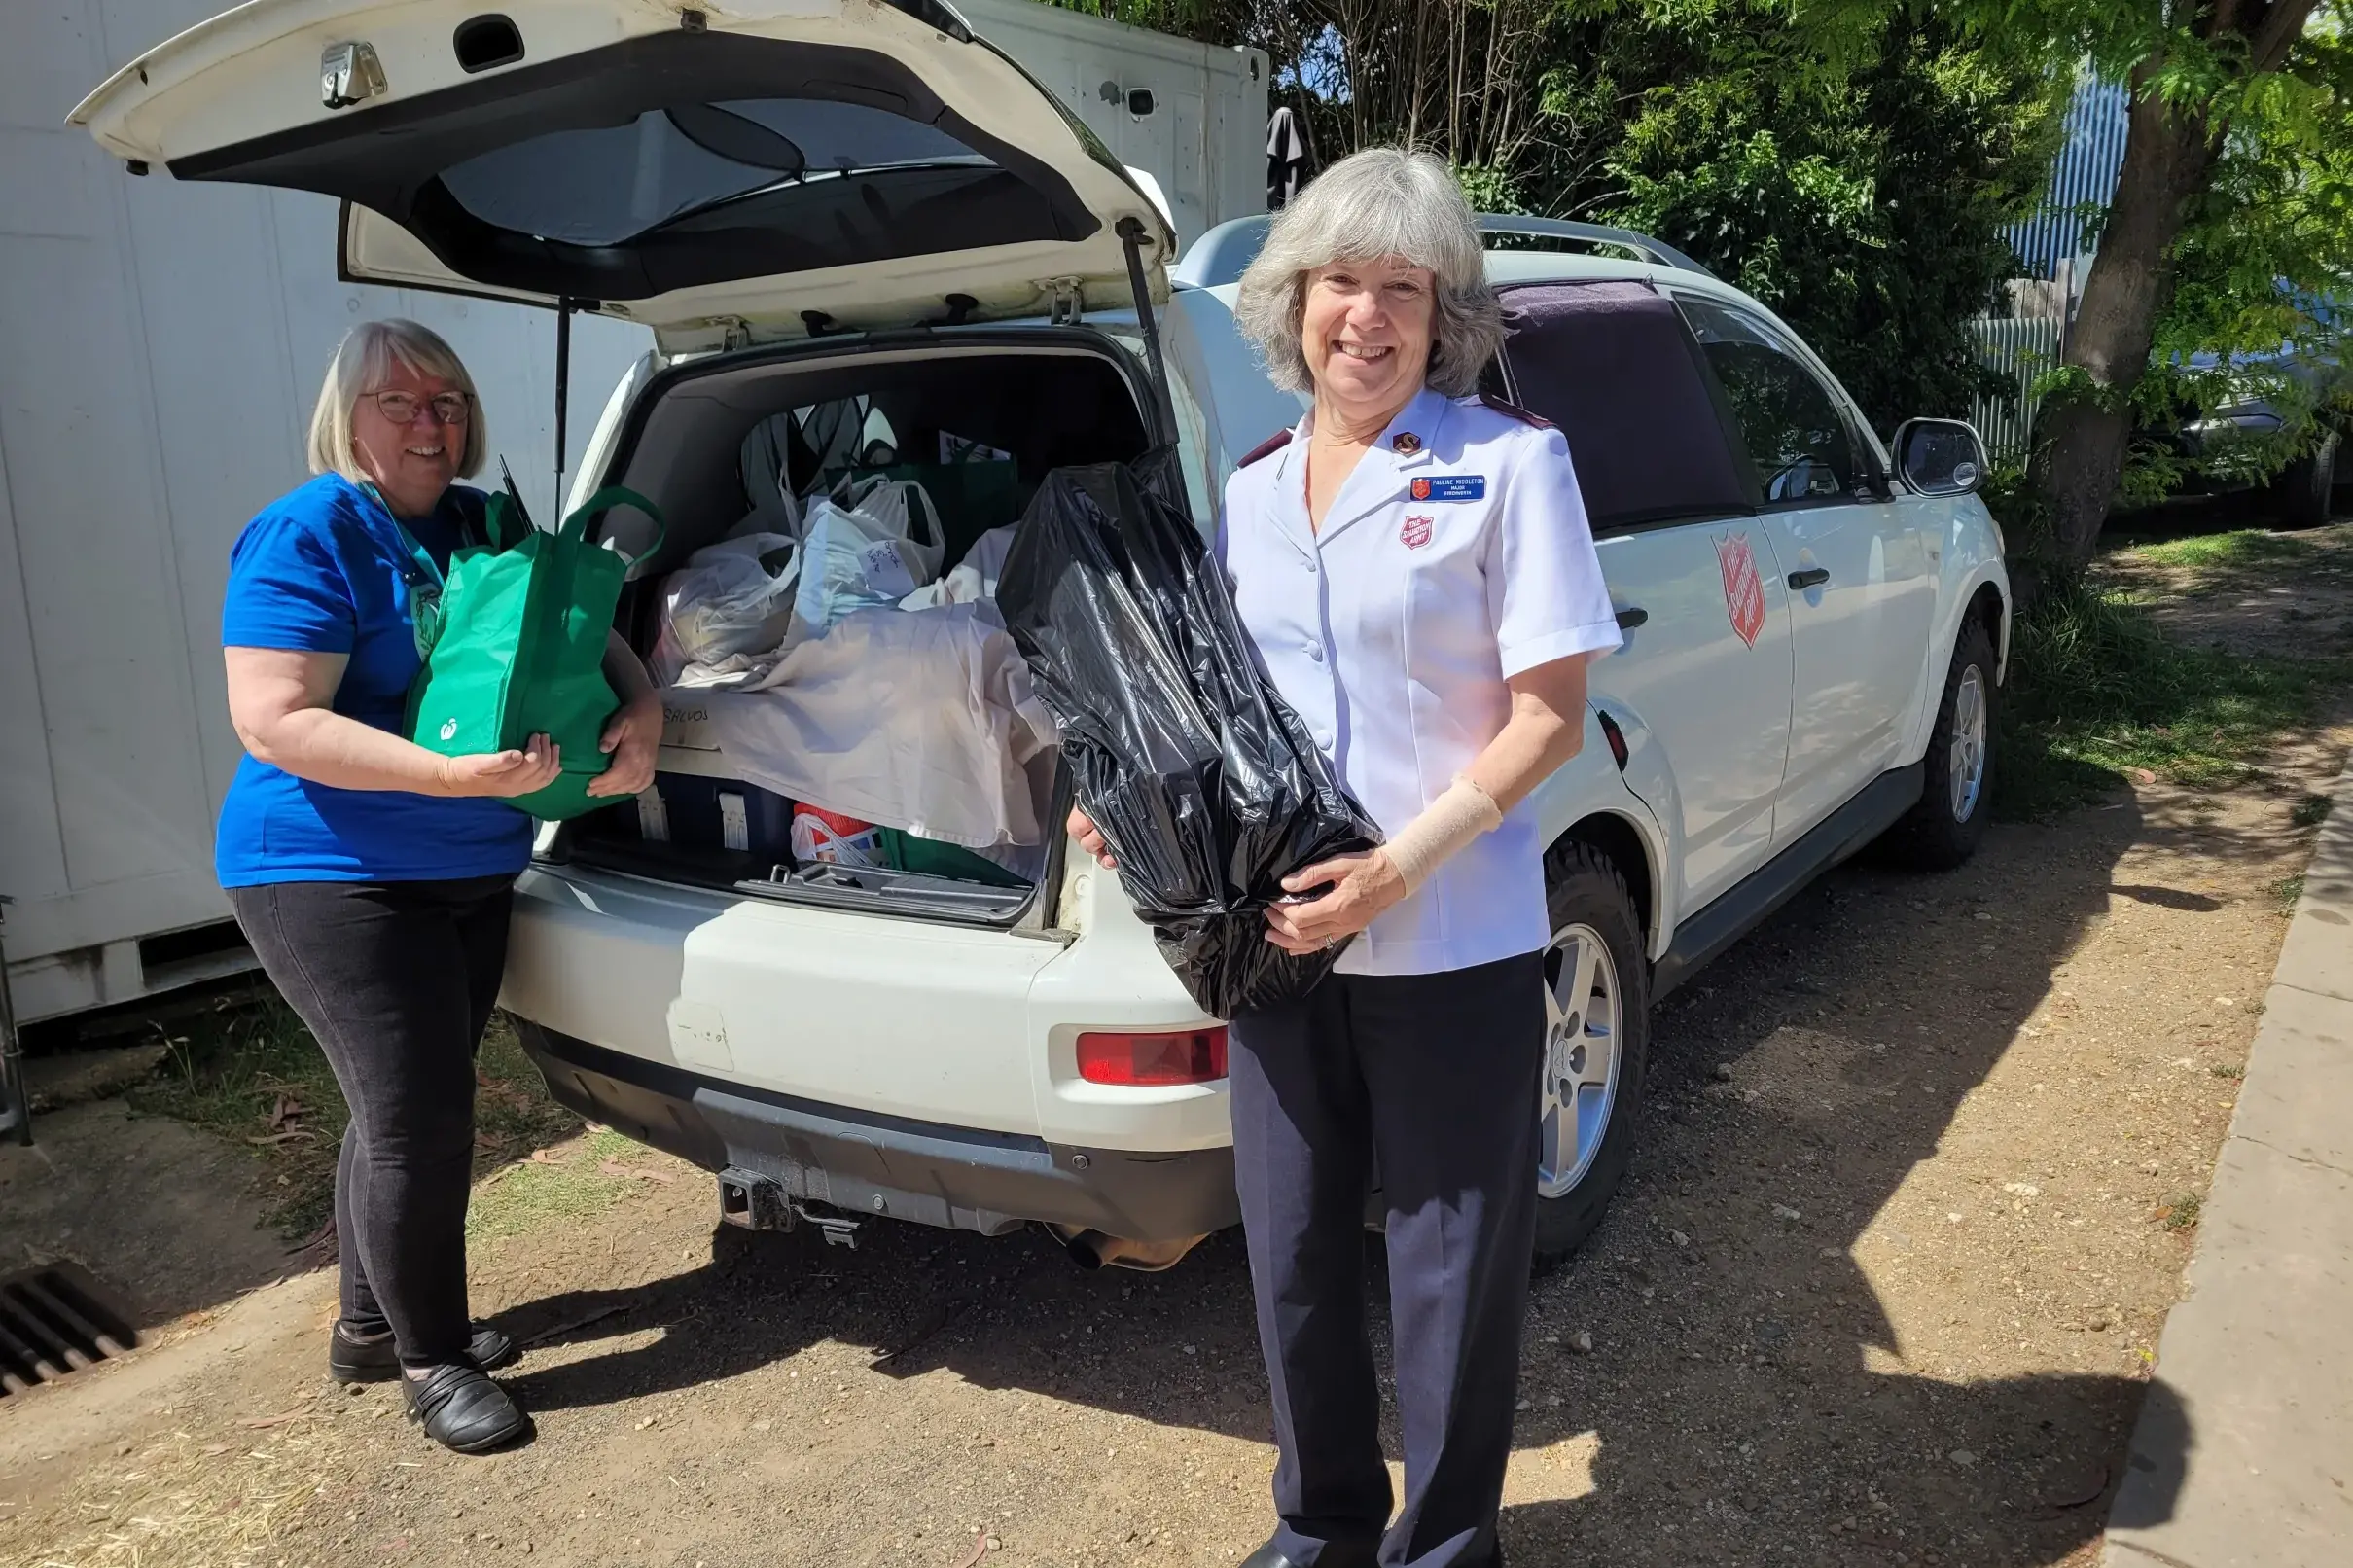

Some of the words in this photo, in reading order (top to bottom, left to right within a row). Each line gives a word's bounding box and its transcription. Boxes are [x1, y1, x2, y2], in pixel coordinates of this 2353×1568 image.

[1396, 433, 1419, 452] S
[1402, 522, 1432, 539] SALVATION
[1408, 518, 1422, 529] THE
[1409, 530, 1427, 545] ARMY
[1727, 543, 1740, 580] THE
[1731, 546, 1754, 620] SALVATION
[1744, 578, 1759, 634] ARMY
